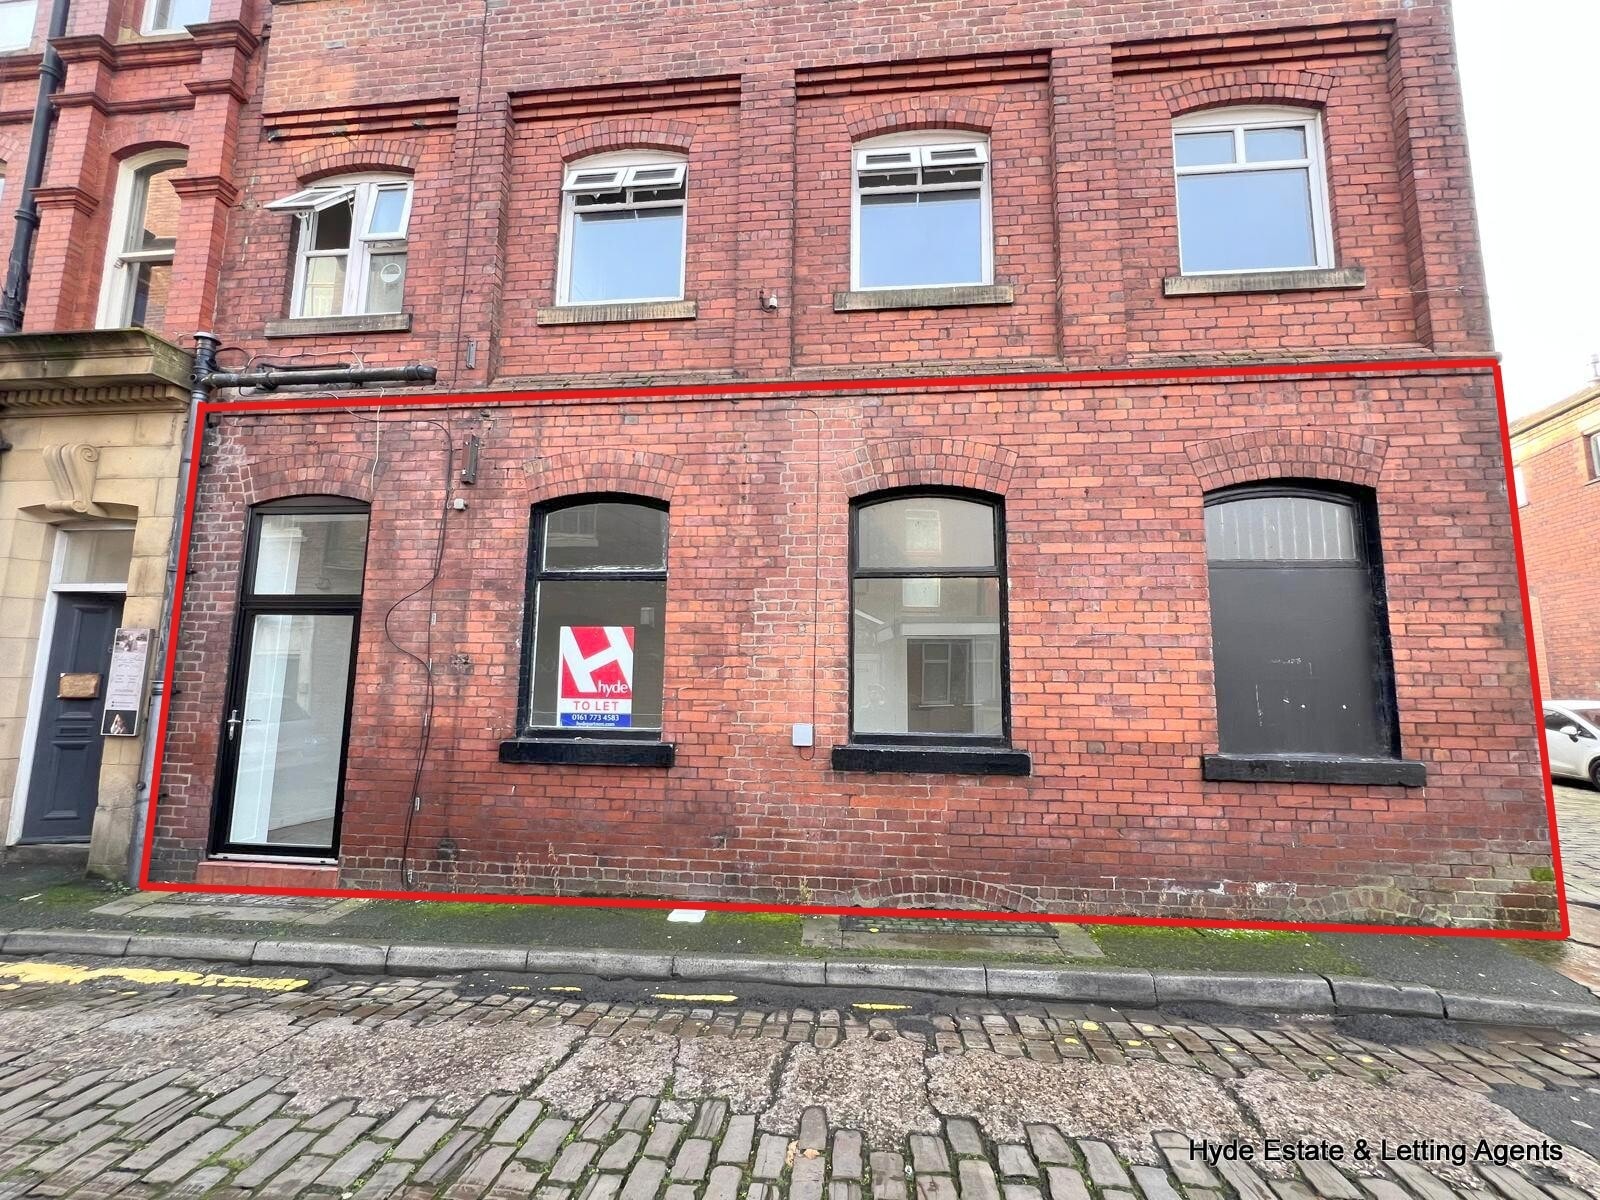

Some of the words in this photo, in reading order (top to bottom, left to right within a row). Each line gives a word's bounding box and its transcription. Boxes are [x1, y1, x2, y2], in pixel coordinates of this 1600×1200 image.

[597, 680, 628, 697] hyde
[573, 701, 590, 711] TO
[595, 701, 619, 711] LET
